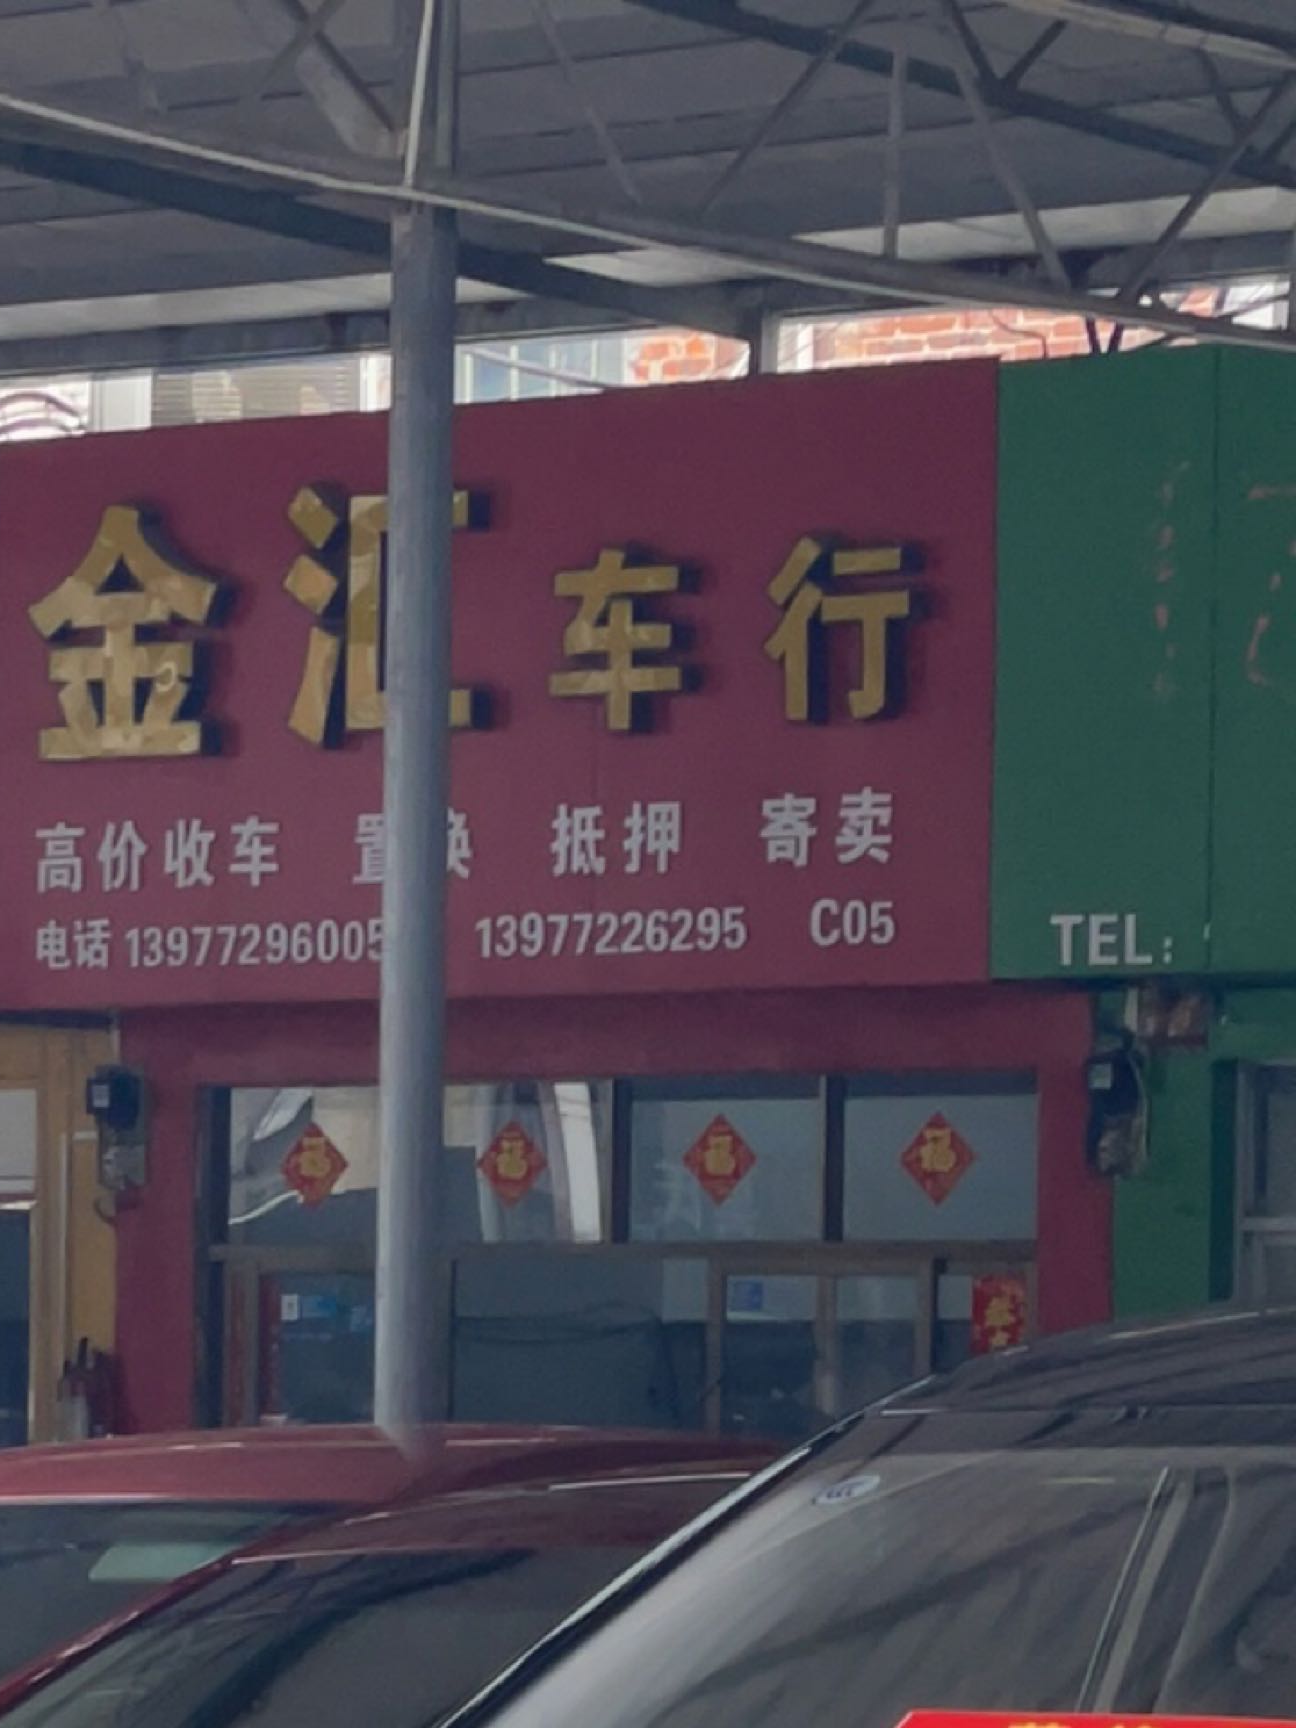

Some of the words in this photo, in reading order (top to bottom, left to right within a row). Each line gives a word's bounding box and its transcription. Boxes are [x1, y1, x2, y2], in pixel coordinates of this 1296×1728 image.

[35, 817, 280, 893] 高价收车
[550, 801, 682, 878] 抵押
[759, 787, 894, 867] 寄卖
[35, 920, 111, 971] 电话
[124, 918, 384, 969] 13977296005
[474, 906, 748, 961] 13977226295
[809, 898, 896, 949] C05
